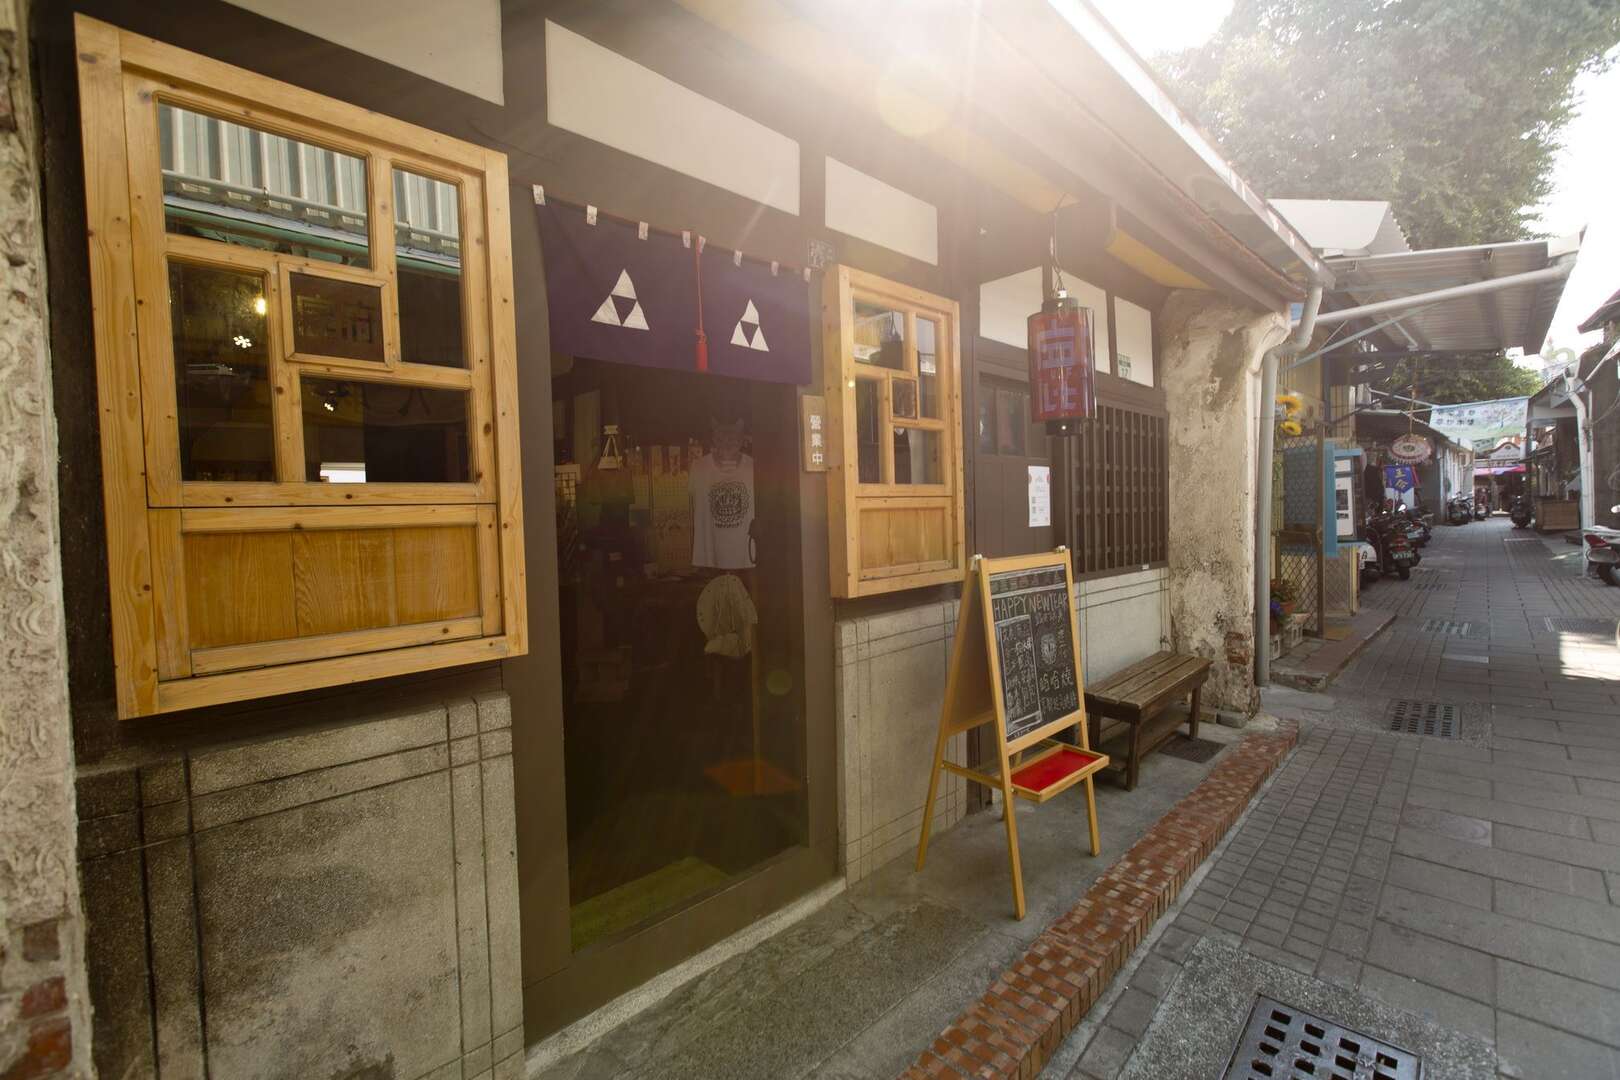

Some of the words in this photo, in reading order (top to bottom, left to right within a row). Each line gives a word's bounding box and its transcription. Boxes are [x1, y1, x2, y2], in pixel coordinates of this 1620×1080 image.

[809, 414, 825, 465] 營業中
[993, 596, 1027, 620] HAPPY
